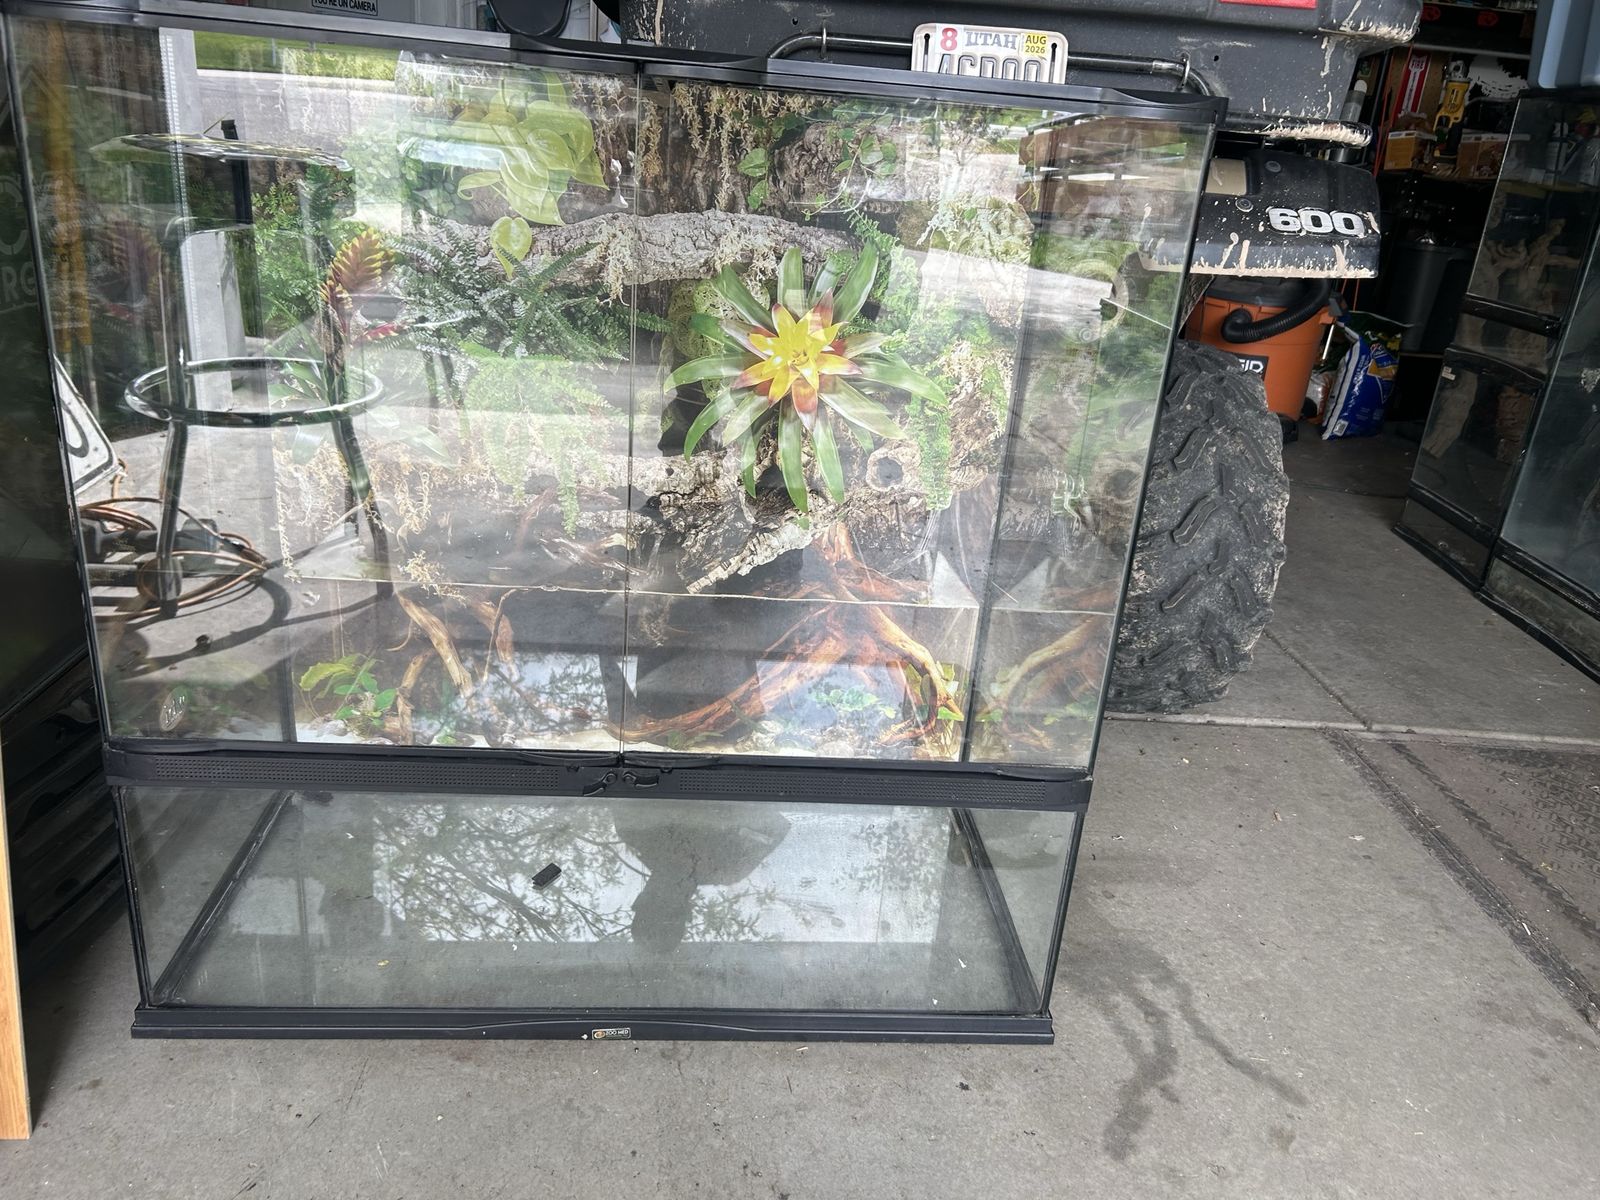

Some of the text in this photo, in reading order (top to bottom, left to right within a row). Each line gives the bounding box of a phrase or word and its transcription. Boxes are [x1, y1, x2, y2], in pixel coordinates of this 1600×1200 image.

[349, 0, 377, 12] CAMERA
[940, 27, 958, 51] 8
[965, 31, 1018, 50] UTAH
[1025, 34, 1047, 45] AUG
[1025, 45, 1046, 54] 2026
[1268, 207, 1365, 235] 600
